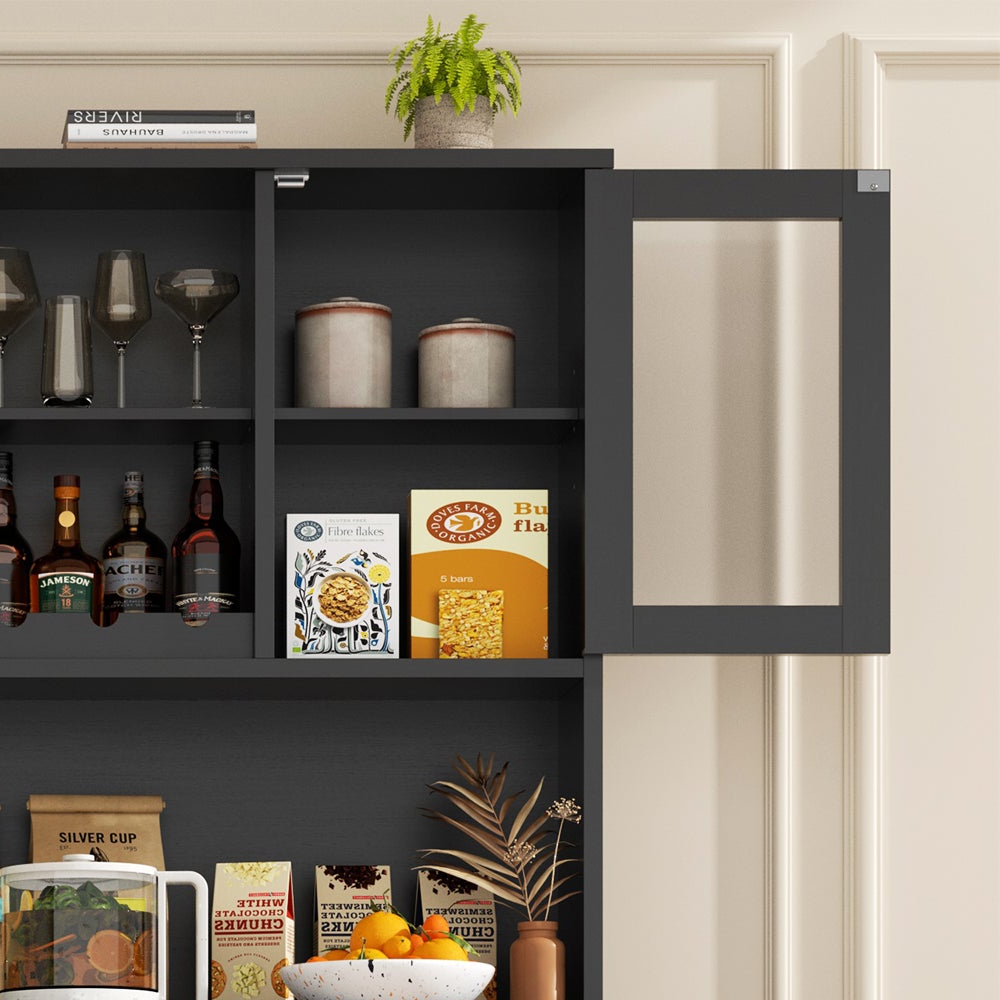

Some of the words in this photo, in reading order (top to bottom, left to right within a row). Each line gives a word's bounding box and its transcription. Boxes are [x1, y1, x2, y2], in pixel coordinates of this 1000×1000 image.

[73, 111, 142, 123] RIVERS
[431, 504, 461, 530] DOVES
[465, 503, 497, 520] FARM
[328, 527, 354, 536] Fibre
[355, 527, 385, 536] flakes
[438, 521, 497, 543] ORGANIC
[40, 576, 92, 588] JAMESON
[440, 575, 447, 583] 5
[450, 575, 474, 583] bars
[62, 598, 72, 608] 18
[59, 832, 105, 843] SILVER
[109, 832, 137, 844] CUP
